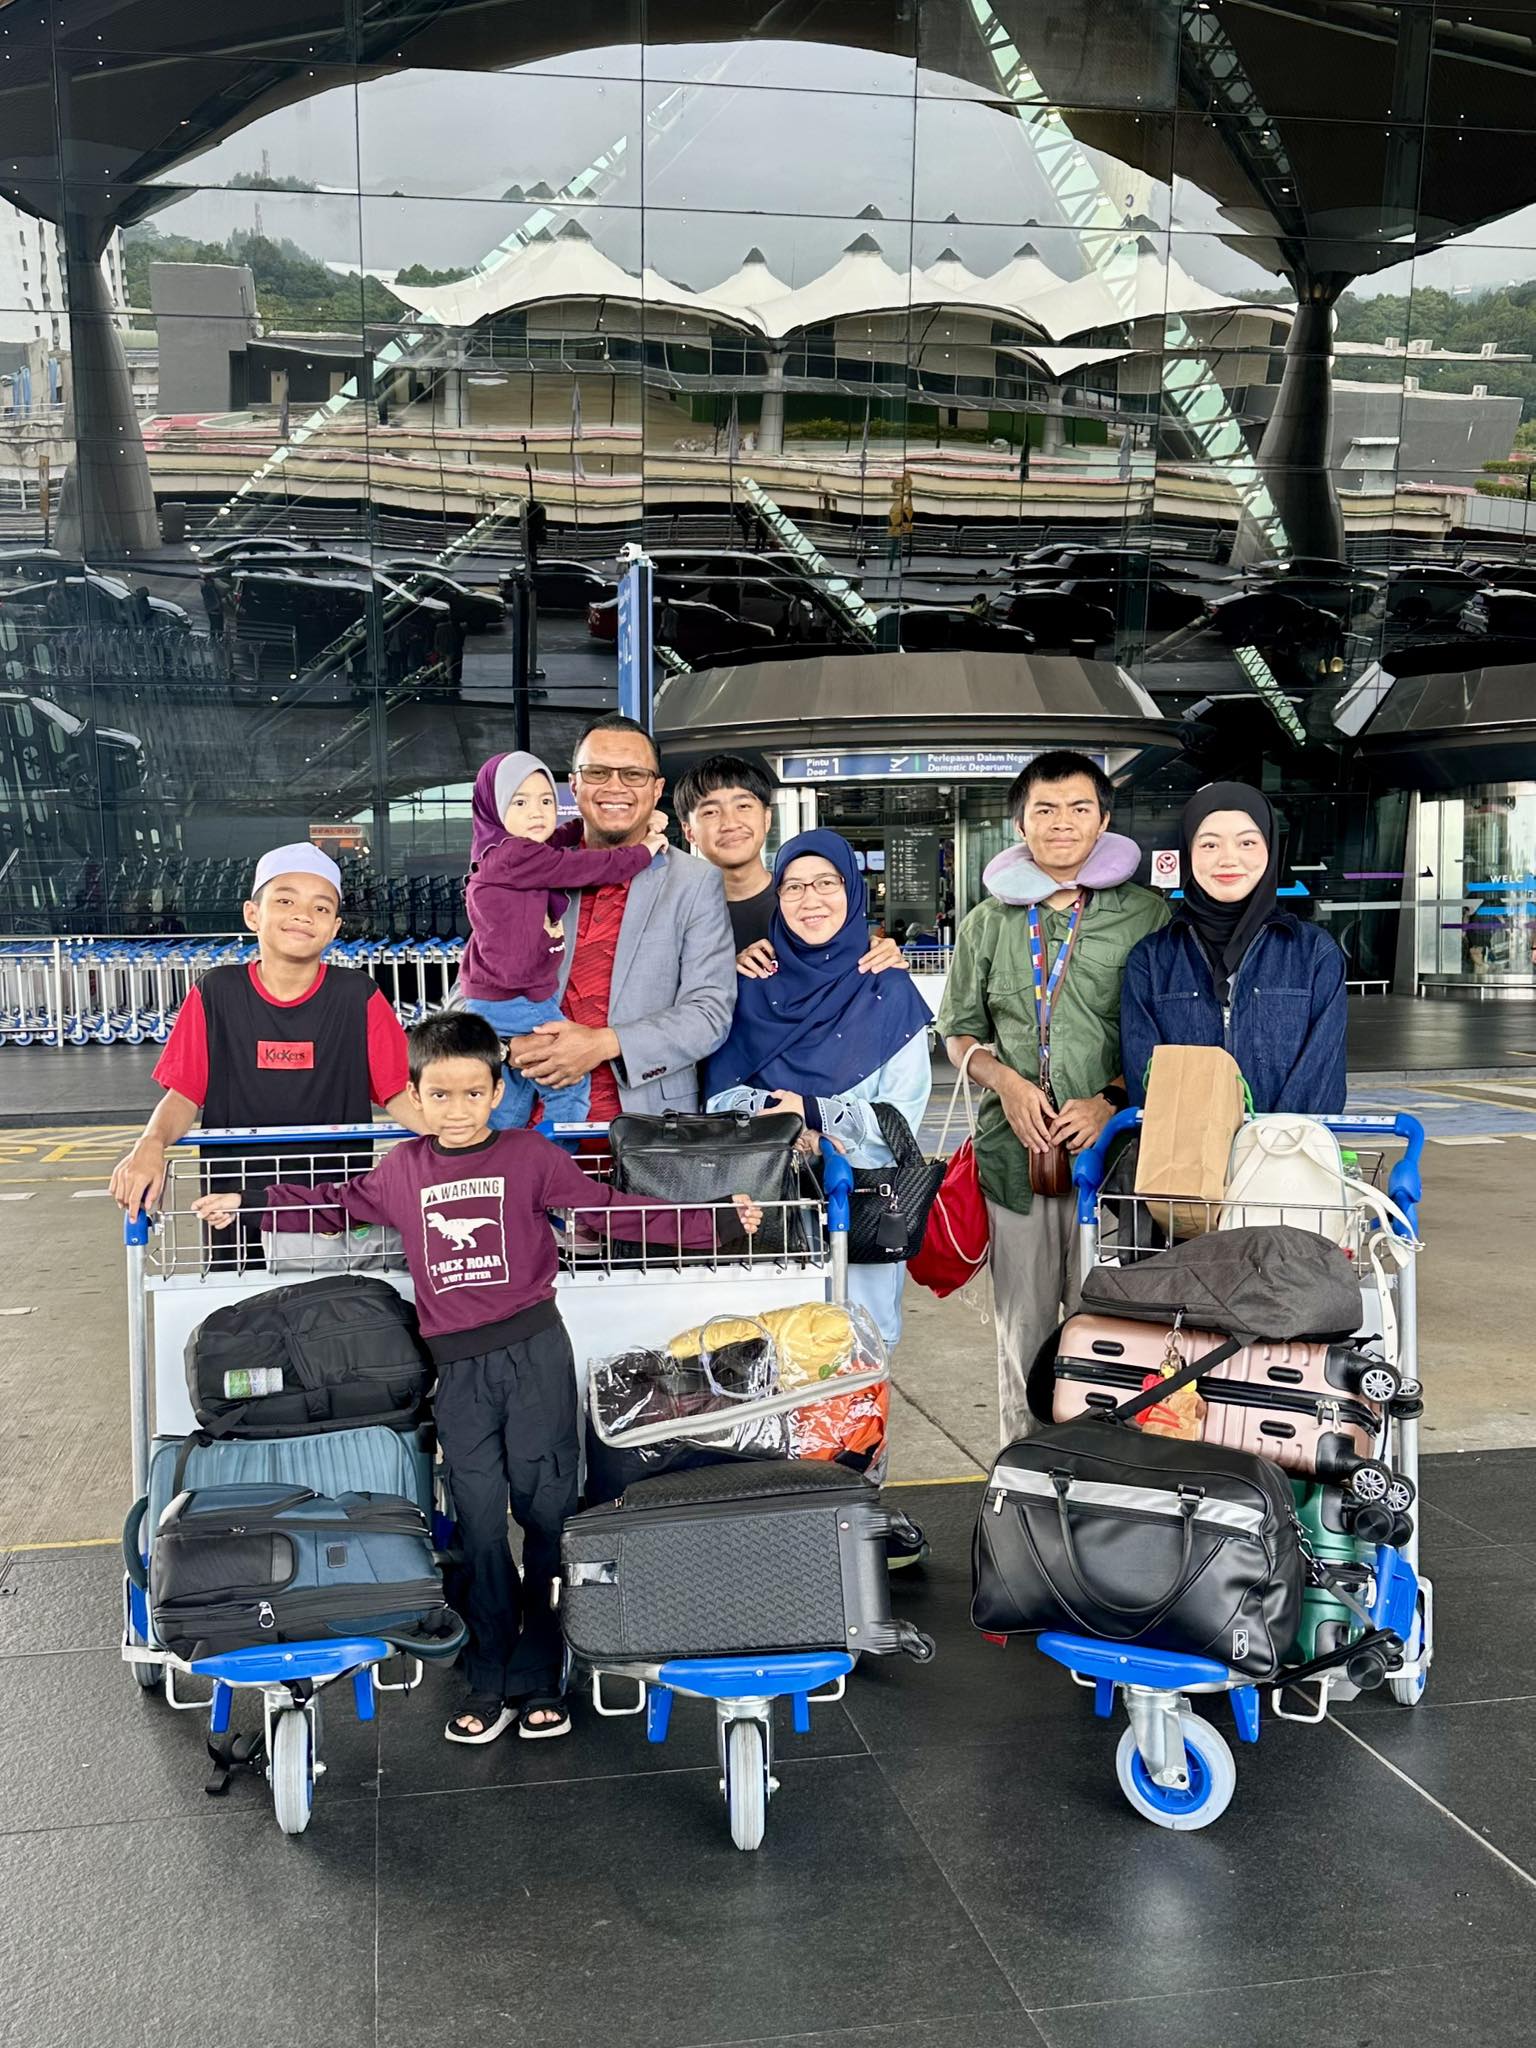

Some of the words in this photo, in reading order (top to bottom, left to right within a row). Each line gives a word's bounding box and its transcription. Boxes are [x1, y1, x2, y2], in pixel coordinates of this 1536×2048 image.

[806, 758, 830, 767] Pintu
[927, 753, 976, 763] Perlepasan
[977, 753, 1005, 762] Dalam
[1006, 753, 1033, 764] Negeri
[832, 757, 839, 774] 1
[927, 763, 967, 772] Domestic
[968, 763, 1013, 773] Departures
[806, 768, 828, 777] Door
[1490, 875, 1524, 884] WELC
[441, 1180, 500, 1200] WARNING
[466, 1255, 502, 1270] ROAR
[464, 1270, 491, 1281] ENTER
